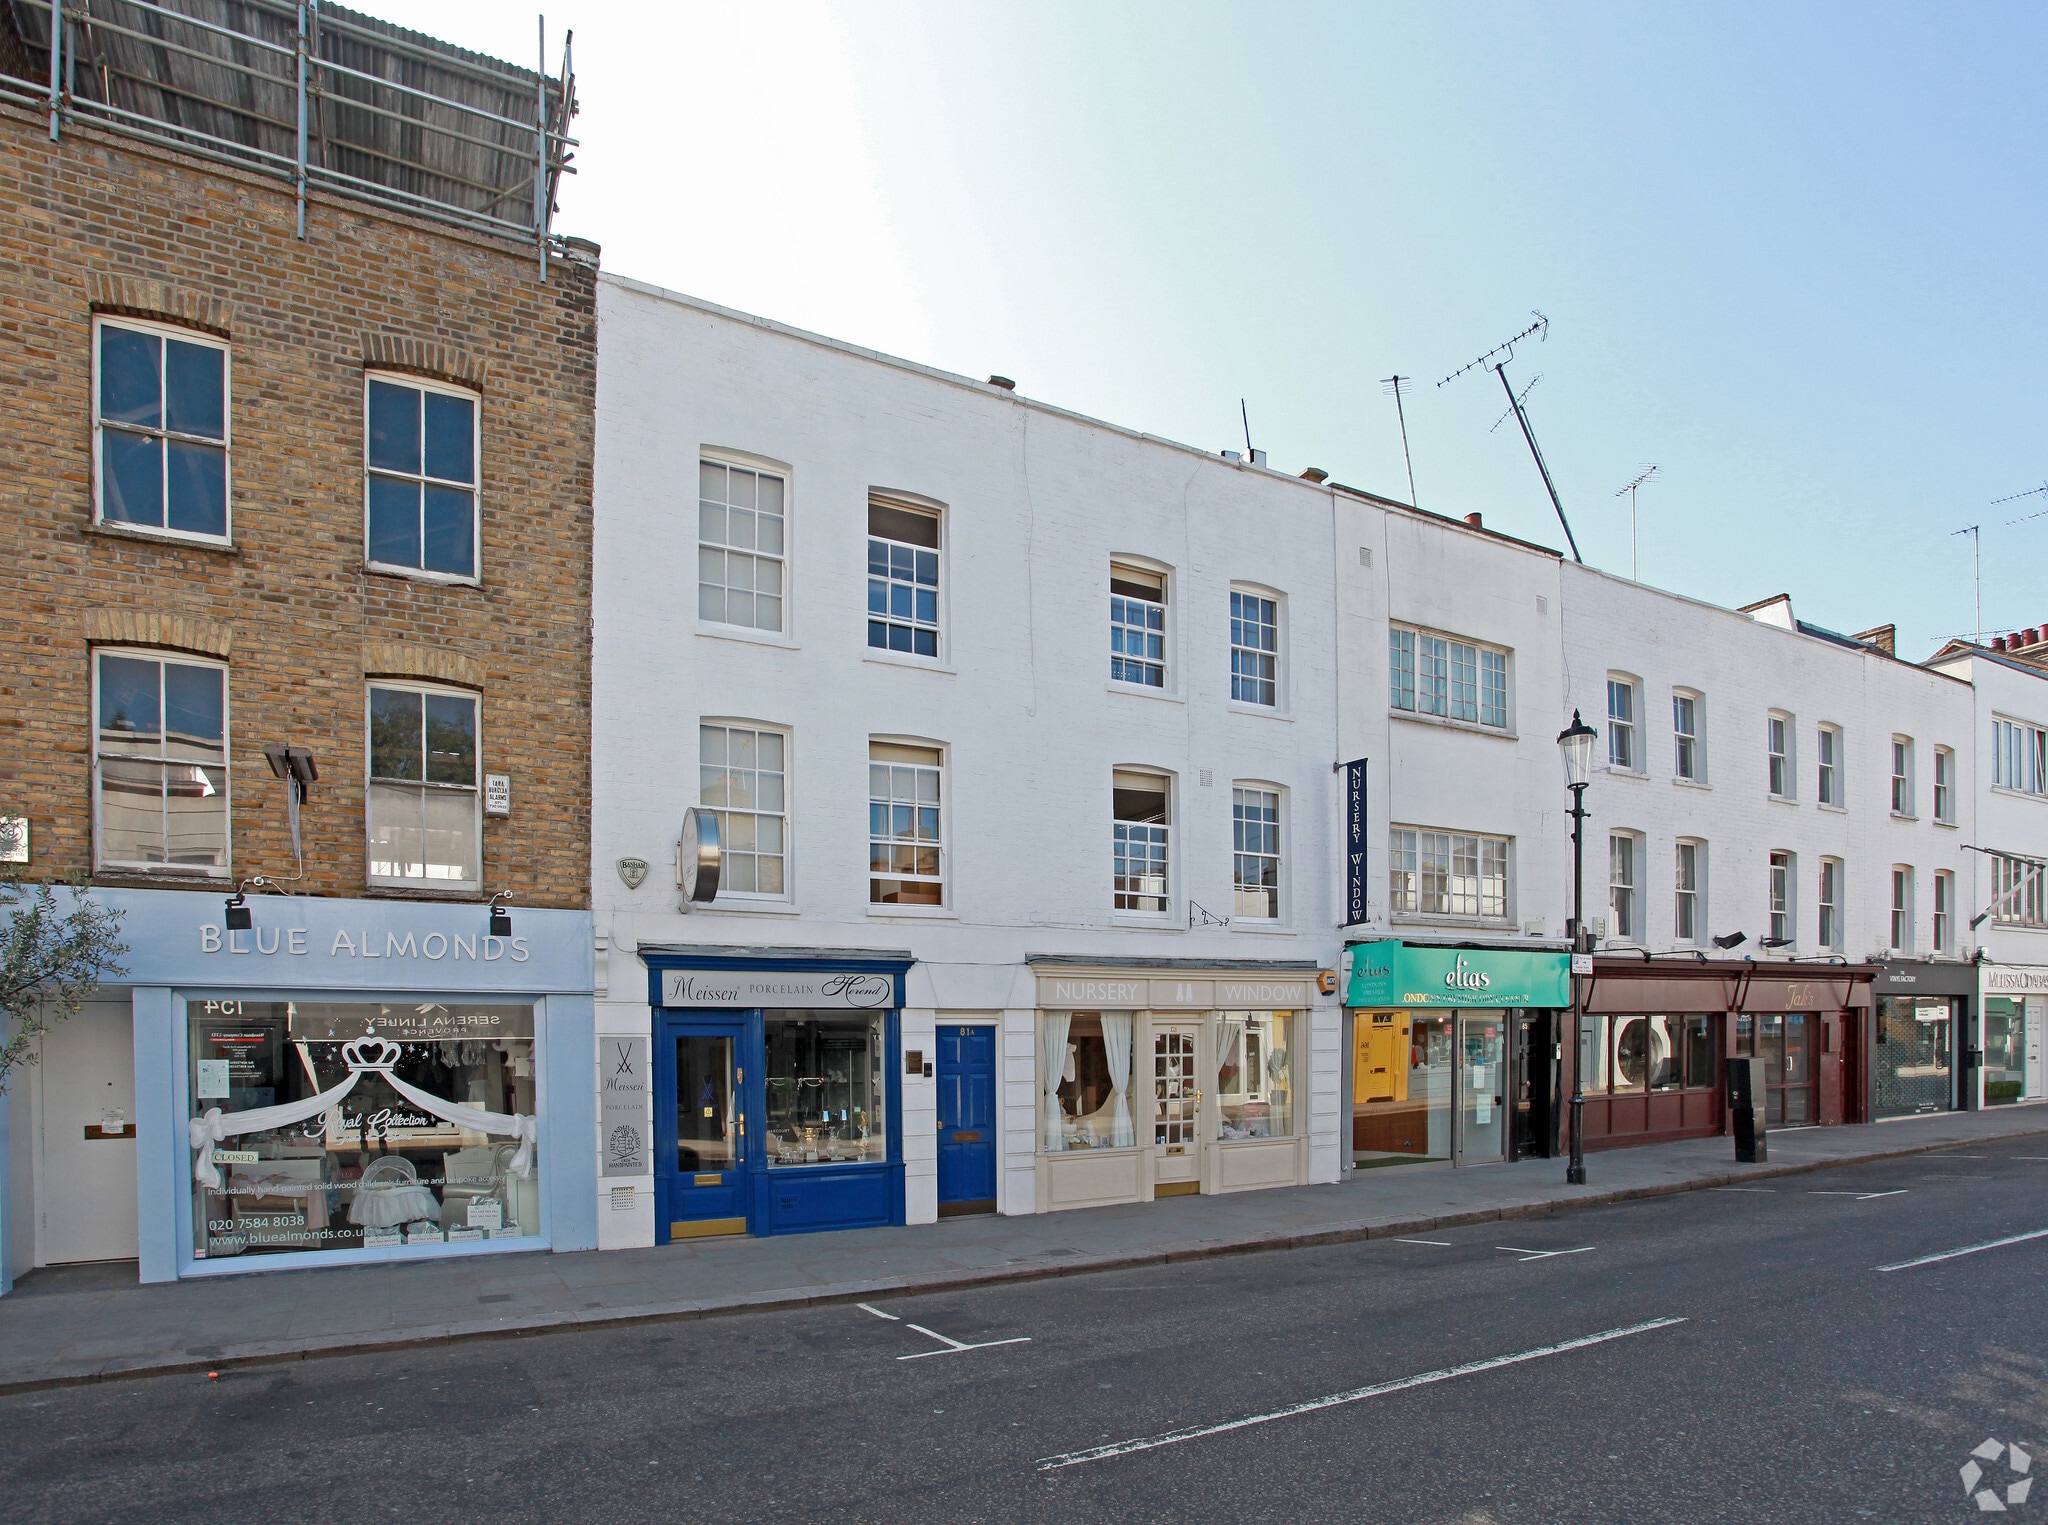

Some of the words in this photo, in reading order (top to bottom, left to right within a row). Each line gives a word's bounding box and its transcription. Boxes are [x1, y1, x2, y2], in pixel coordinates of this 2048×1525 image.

[1351, 766, 1362, 844] NURSERY
[622, 861, 646, 869] BANHAM
[1350, 852, 1364, 921] WINDOW
[199, 923, 308, 955] BLUE
[331, 928, 530, 962] ALMONDS
[1357, 954, 1390, 978] elias
[1446, 952, 1491, 987] elias
[668, 975, 739, 1001] Meissen
[749, 984, 814, 994] PORCELAIN
[1055, 982, 1138, 1001] NURSERY
[1225, 985, 1301, 1001] WINDOW
[605, 1077, 644, 1091] Meissen
[367, 1108, 428, 1138] Collection
[214, 1153, 255, 1163] CLOSED
[208, 1185, 255, 1196] Individually
[258, 1182, 312, 1194] hand-painted
[313, 1182, 333, 1191] solid
[334, 1181, 356, 1189] wood
[430, 1176, 445, 1185] and
[209, 1219, 234, 1231] 020
[237, 1217, 269, 1229] 7584
[273, 1215, 305, 1227] 8038
[209, 1228, 371, 1246] www.bluealmonds.co.uk
